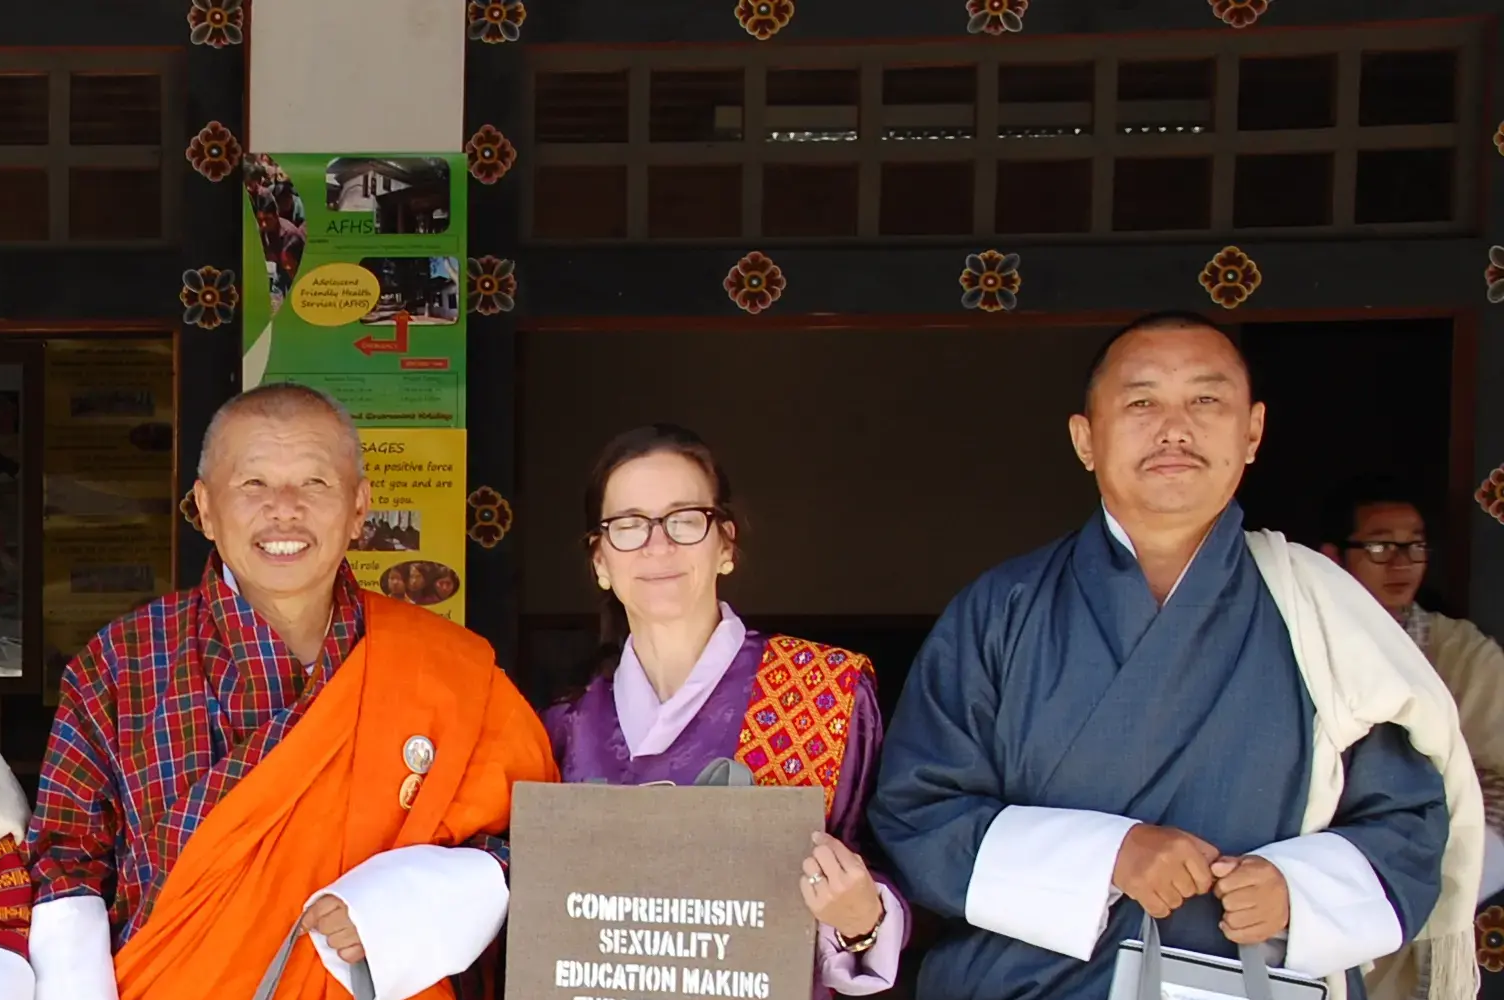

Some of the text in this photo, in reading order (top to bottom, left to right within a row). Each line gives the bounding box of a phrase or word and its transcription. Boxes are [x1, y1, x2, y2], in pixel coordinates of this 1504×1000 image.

[326, 219, 373, 234] AFHS
[300, 288, 371, 299] Friendly Health
[360, 442, 405, 454] SAGES
[373, 463, 380, 472] a
[384, 461, 423, 475] positive
[426, 461, 453, 472] force
[389, 481, 408, 491] you
[412, 478, 432, 488] and
[435, 480, 453, 488] are
[378, 496, 389, 504] to
[360, 560, 380, 570] role
[566, 891, 765, 928] COMPREHENSIVE
[598, 928, 730, 960] SEXUALITY
[555, 960, 770, 999] EDUCATION MAKING
